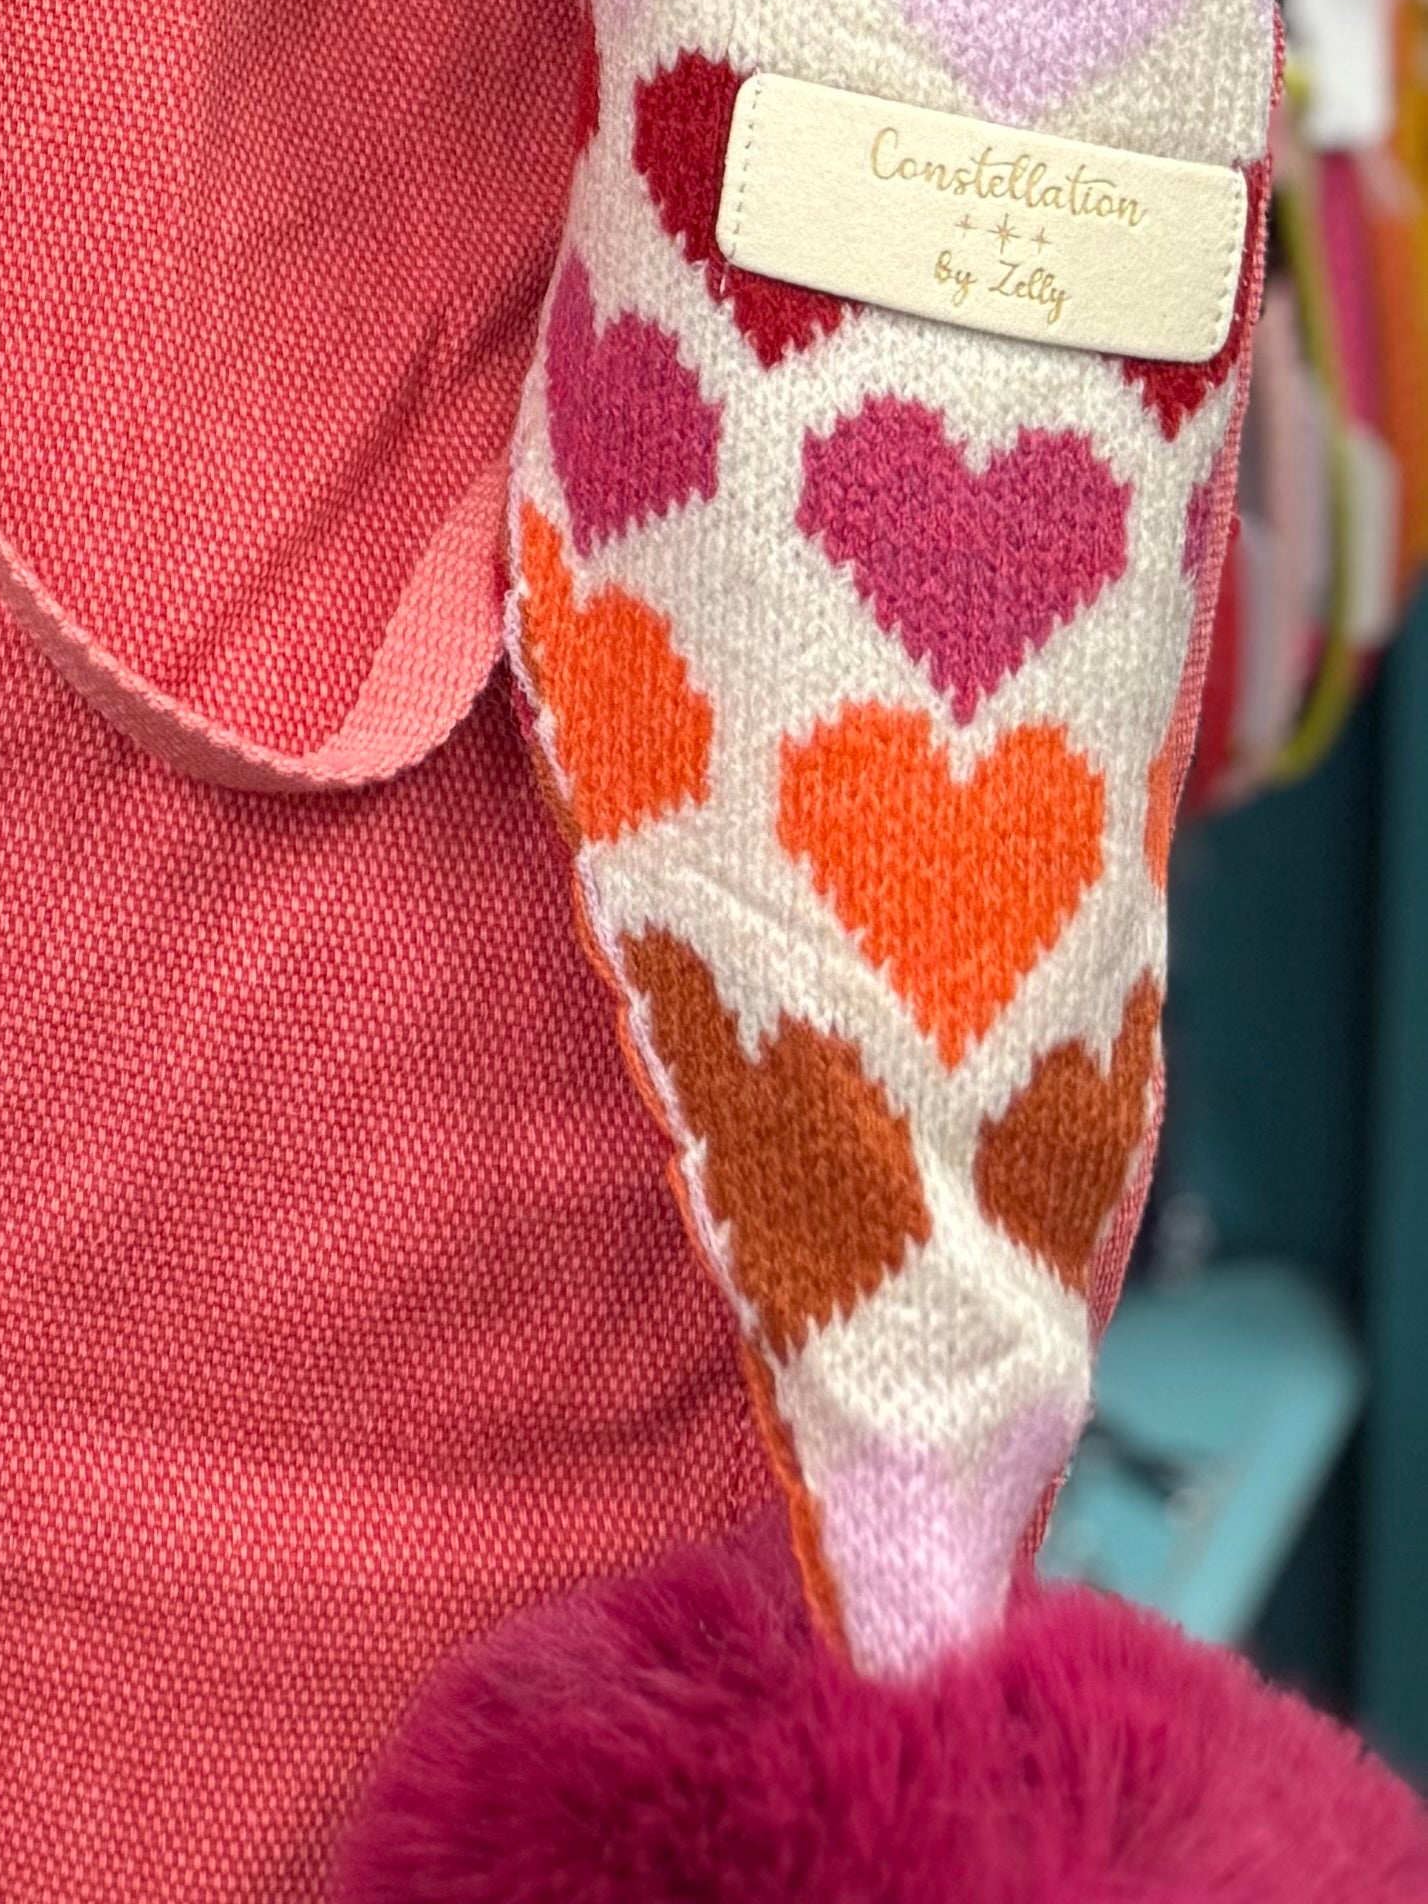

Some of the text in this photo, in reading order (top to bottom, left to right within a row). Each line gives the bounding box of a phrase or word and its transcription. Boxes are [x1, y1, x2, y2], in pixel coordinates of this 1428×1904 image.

[871, 127, 1147, 226] Constellation
[934, 249, 1073, 324] by Zelly
